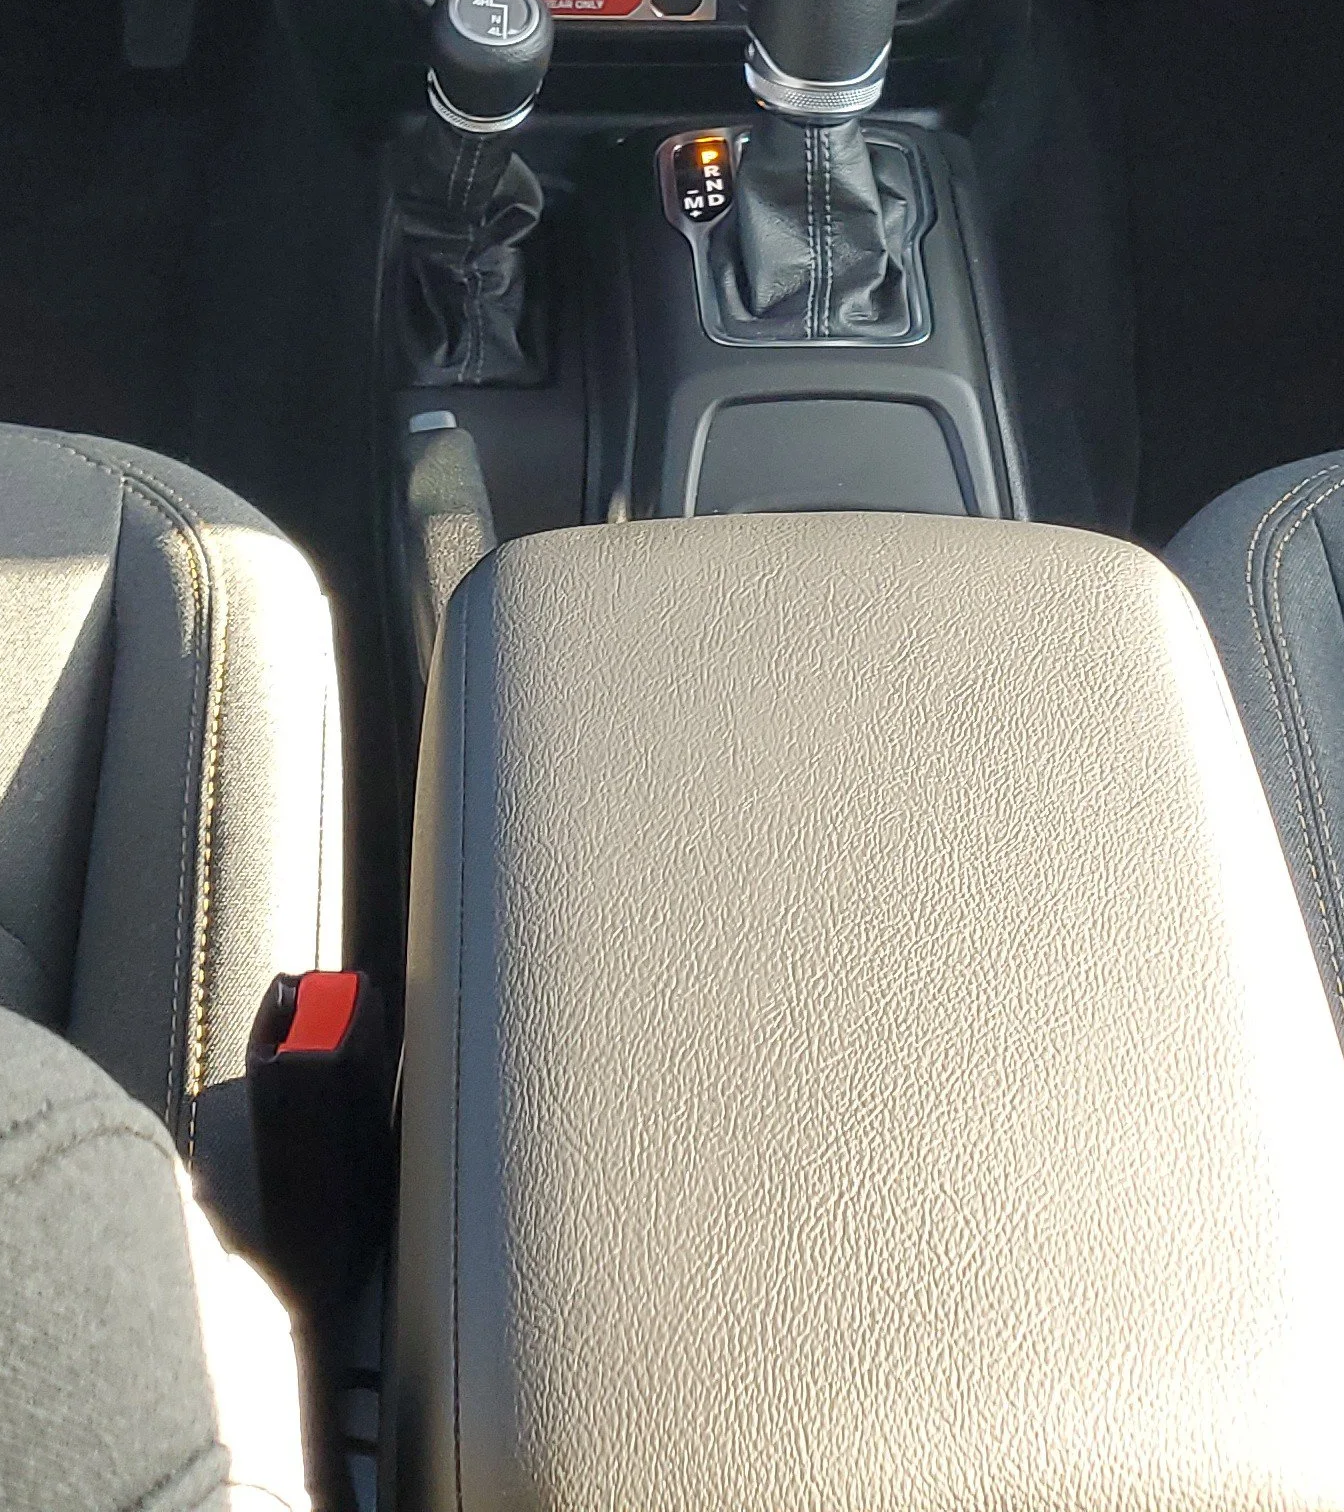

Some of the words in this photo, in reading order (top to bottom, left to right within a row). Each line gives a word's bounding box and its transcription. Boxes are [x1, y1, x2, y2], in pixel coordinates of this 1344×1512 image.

[574, 0, 605, 10] ONLY
[491, 14, 501, 24] N
[701, 150, 718, 165] P
[703, 165, 721, 178] R
[706, 178, 723, 192] N
[683, 195, 704, 210] M
[708, 193, 726, 207] D
